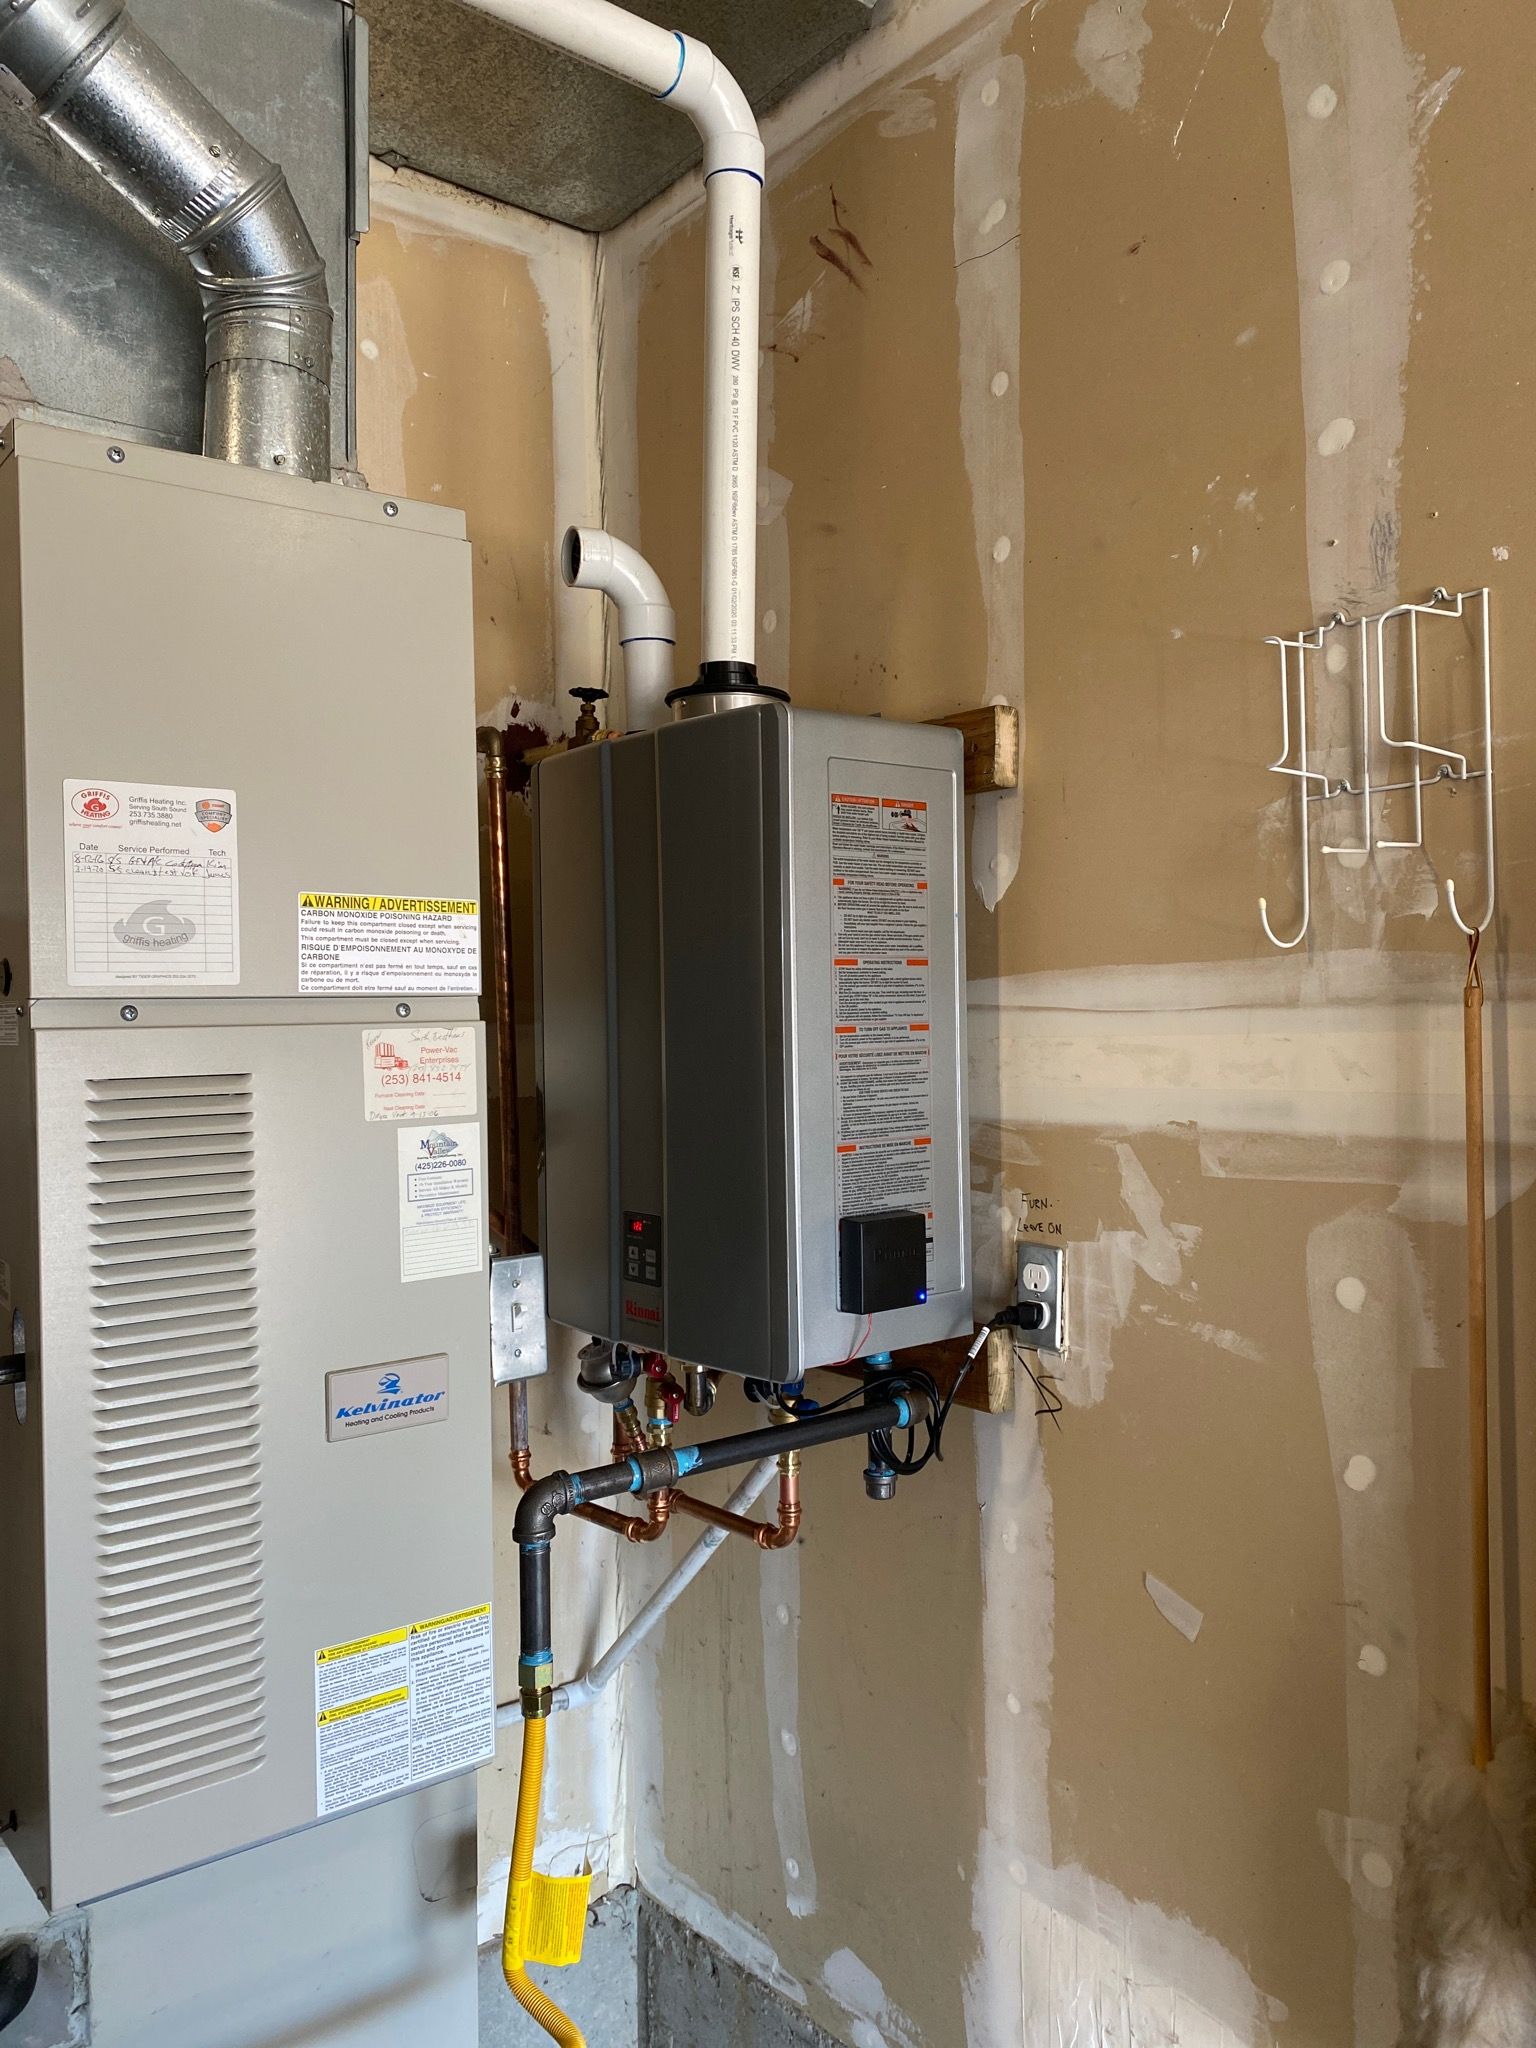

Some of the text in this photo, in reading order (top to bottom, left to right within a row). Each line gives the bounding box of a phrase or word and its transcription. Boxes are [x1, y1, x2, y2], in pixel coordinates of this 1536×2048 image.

[732, 266, 740, 279] NSF
[732, 298, 740, 312] IPS
[732, 316, 740, 335] SCH
[732, 336, 740, 347] 40
[732, 349, 740, 371] DWV
[80, 790, 111, 801] GRIFFIS
[150, 797, 174, 806] Heating
[80, 809, 111, 818] HEATING
[118, 845, 189, 855] Service Performed
[314, 896, 370, 910] WARNING
[379, 898, 476, 914] ADVERTISSEMENT
[337, 911, 378, 919] MONOXIDE
[142, 916, 166, 936] G
[122, 932, 189, 947] griffis heating
[333, 944, 411, 952] D'EMPOISONNEMENT
[381, 1072, 461, 1087] (253) 841-4514
[420, 1140, 458, 1149] Mountain
[428, 1147, 449, 1156] Valley
[415, 1159, 466, 1171] (425)226-0080
[1048, 1223, 1062, 1235] ON
[626, 1300, 661, 1321] Rinnai
[336, 1391, 445, 1420] Kelvinator
[345, 1418, 369, 1428] Heating
[384, 1411, 408, 1420] Cooling
[410, 1406, 435, 1415] Products
